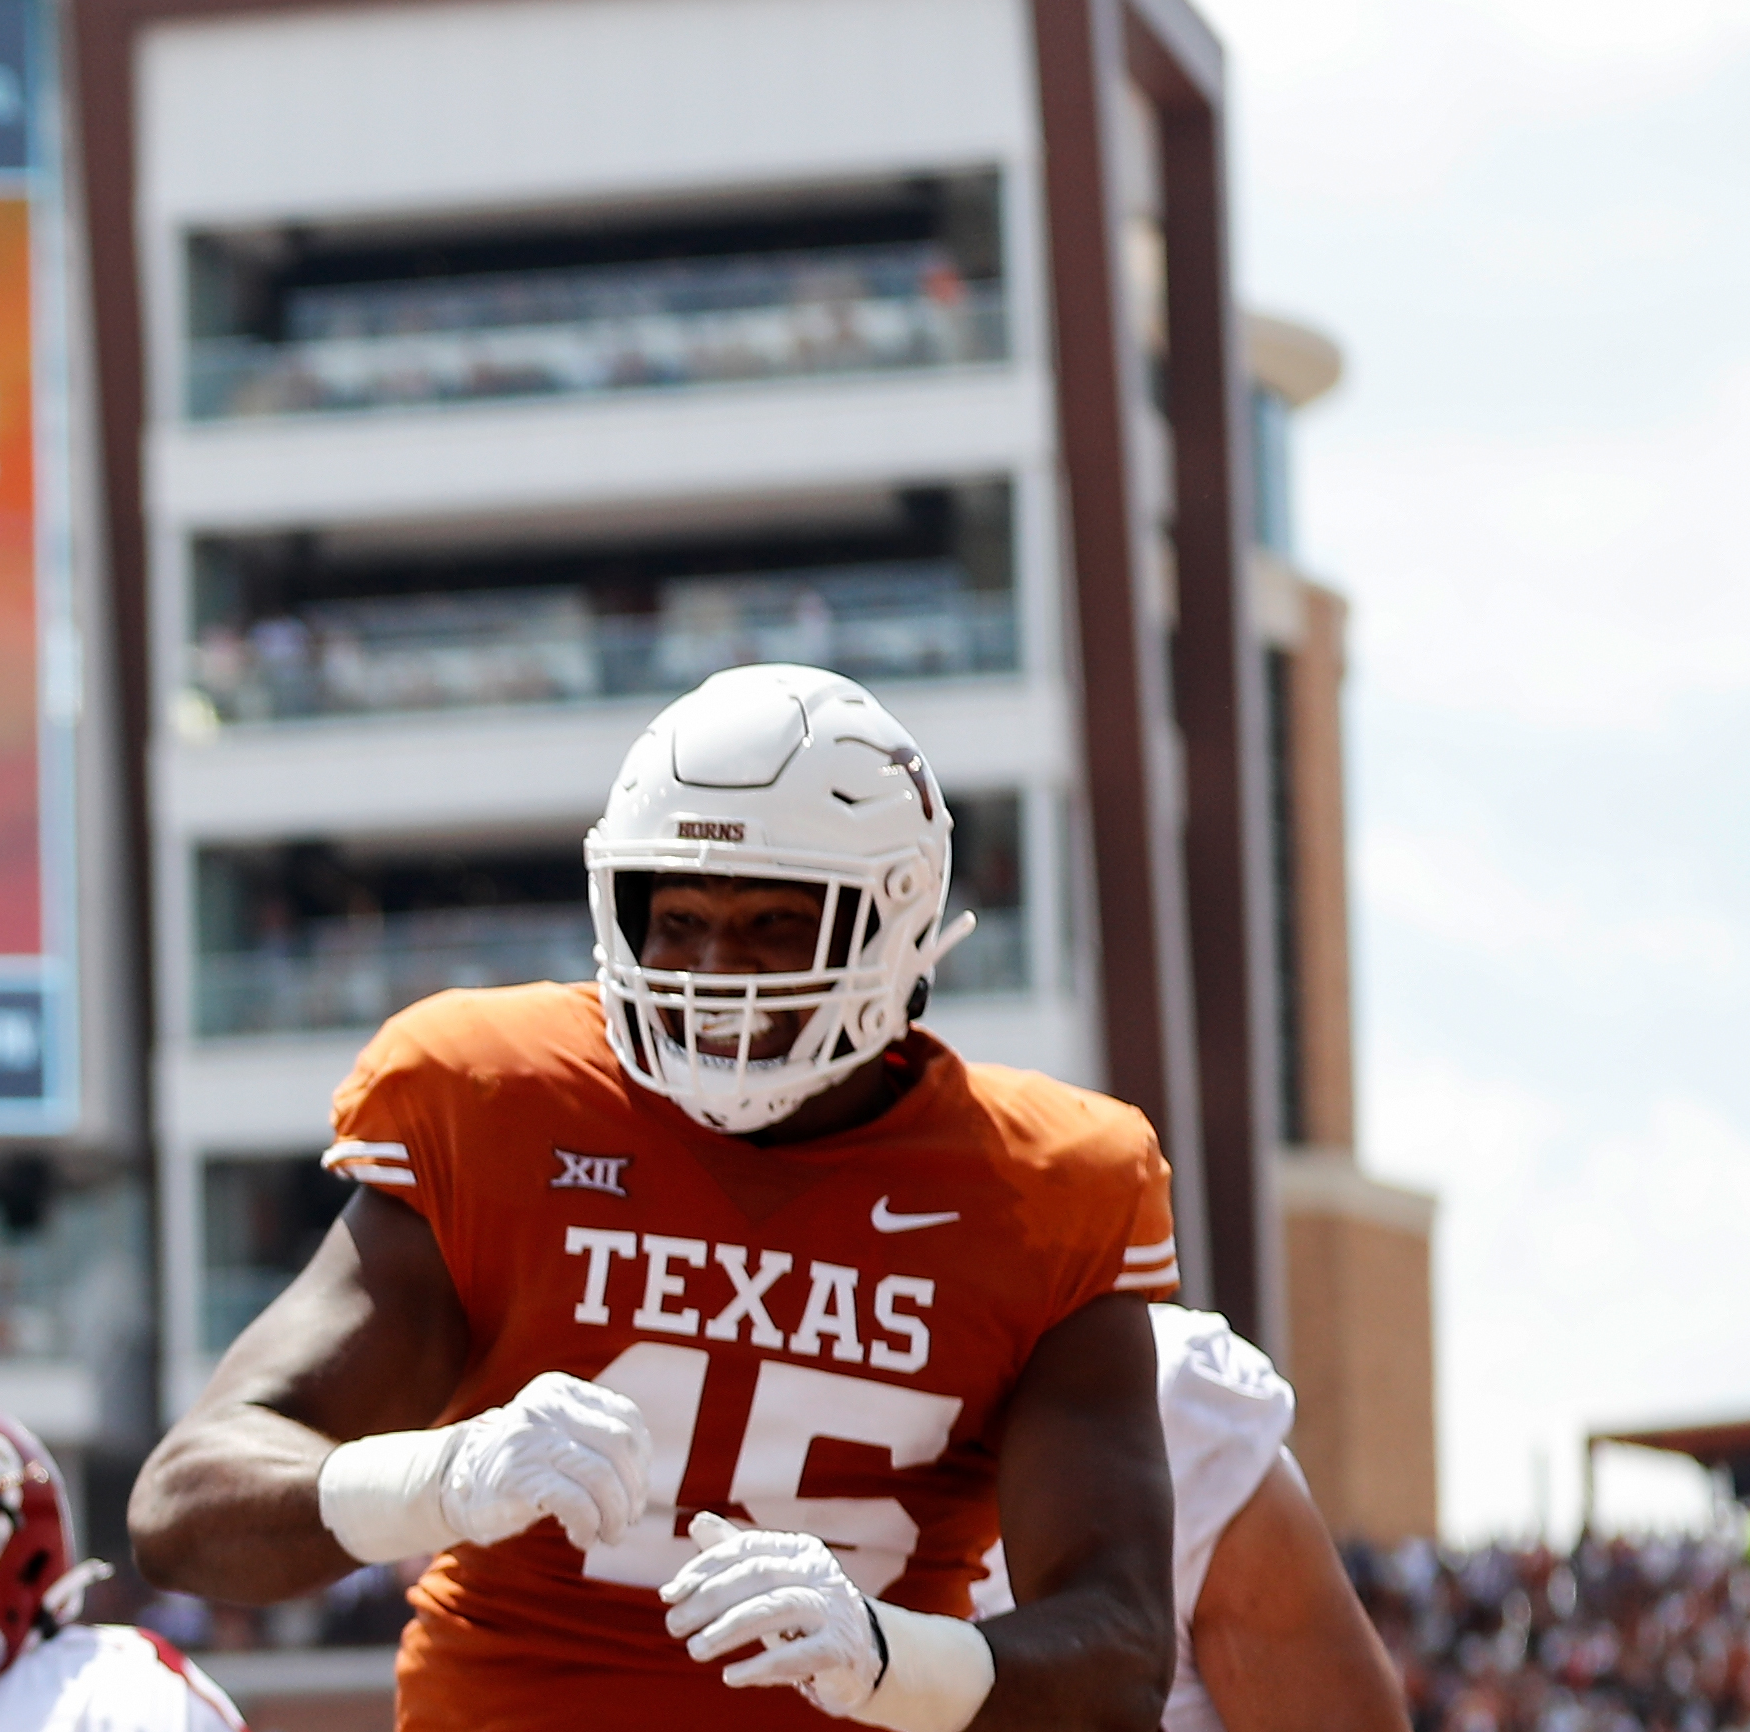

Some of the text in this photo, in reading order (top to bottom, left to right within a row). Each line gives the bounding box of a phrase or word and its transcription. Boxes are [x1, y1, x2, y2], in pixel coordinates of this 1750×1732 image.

[678, 821, 745, 842] HORNS
[549, 1147, 628, 1199] XII
[564, 1226, 935, 1375] TEXAS
